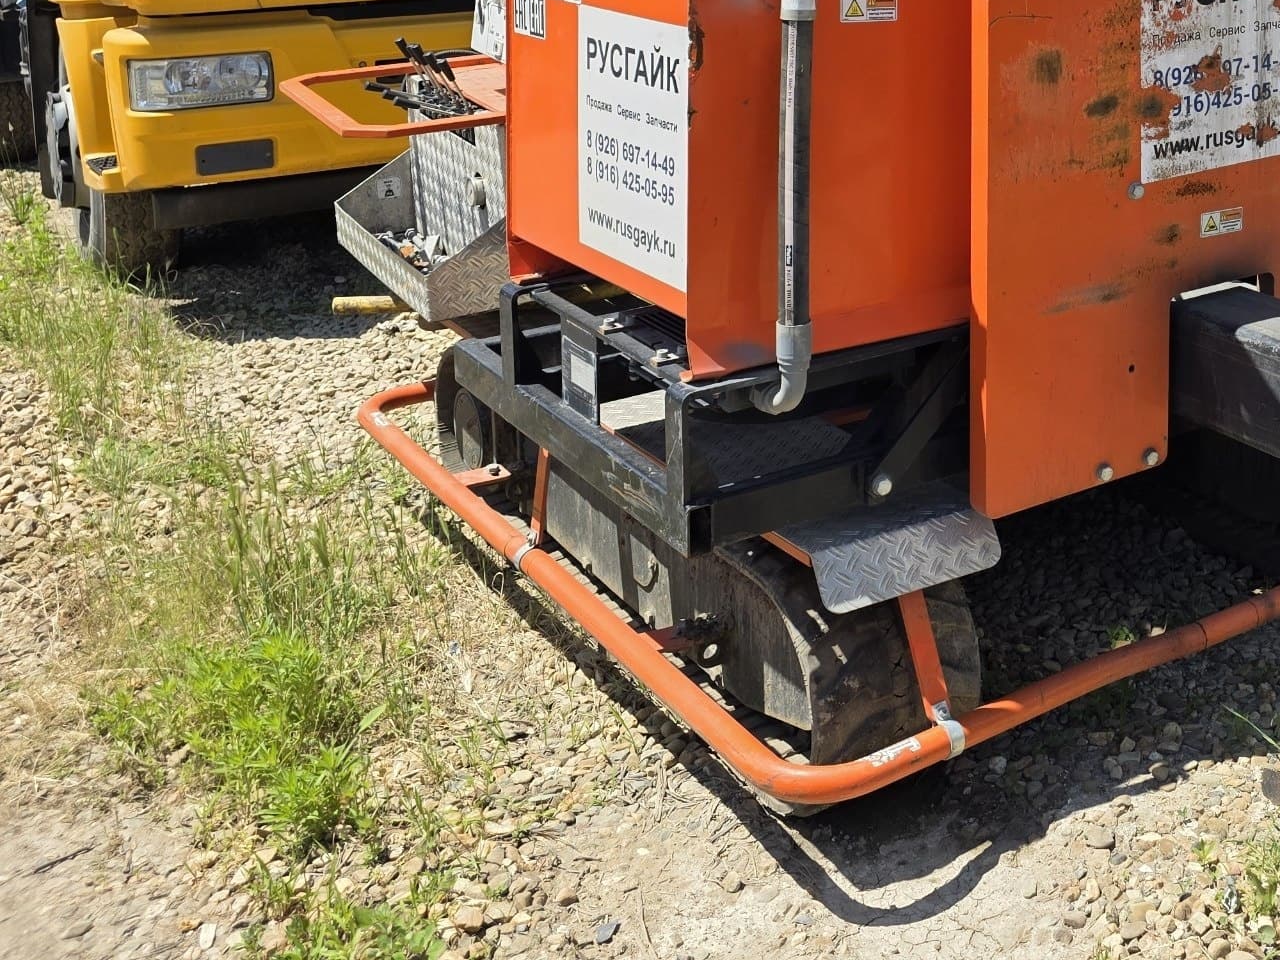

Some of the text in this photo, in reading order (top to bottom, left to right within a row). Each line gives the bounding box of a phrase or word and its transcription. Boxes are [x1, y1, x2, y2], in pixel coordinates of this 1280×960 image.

[1209, 26, 1246, 41] Сервис
[587, 37, 680, 93] РУСГАЙК
[586, 95, 678, 133] Продажа Сервис Запчасти
[587, 130, 675, 176] 8 (926) 697-14-49
[587, 157, 675, 206] 8 (916) 425-05-95
[588, 208, 675, 258] www.rusgayk.ru
